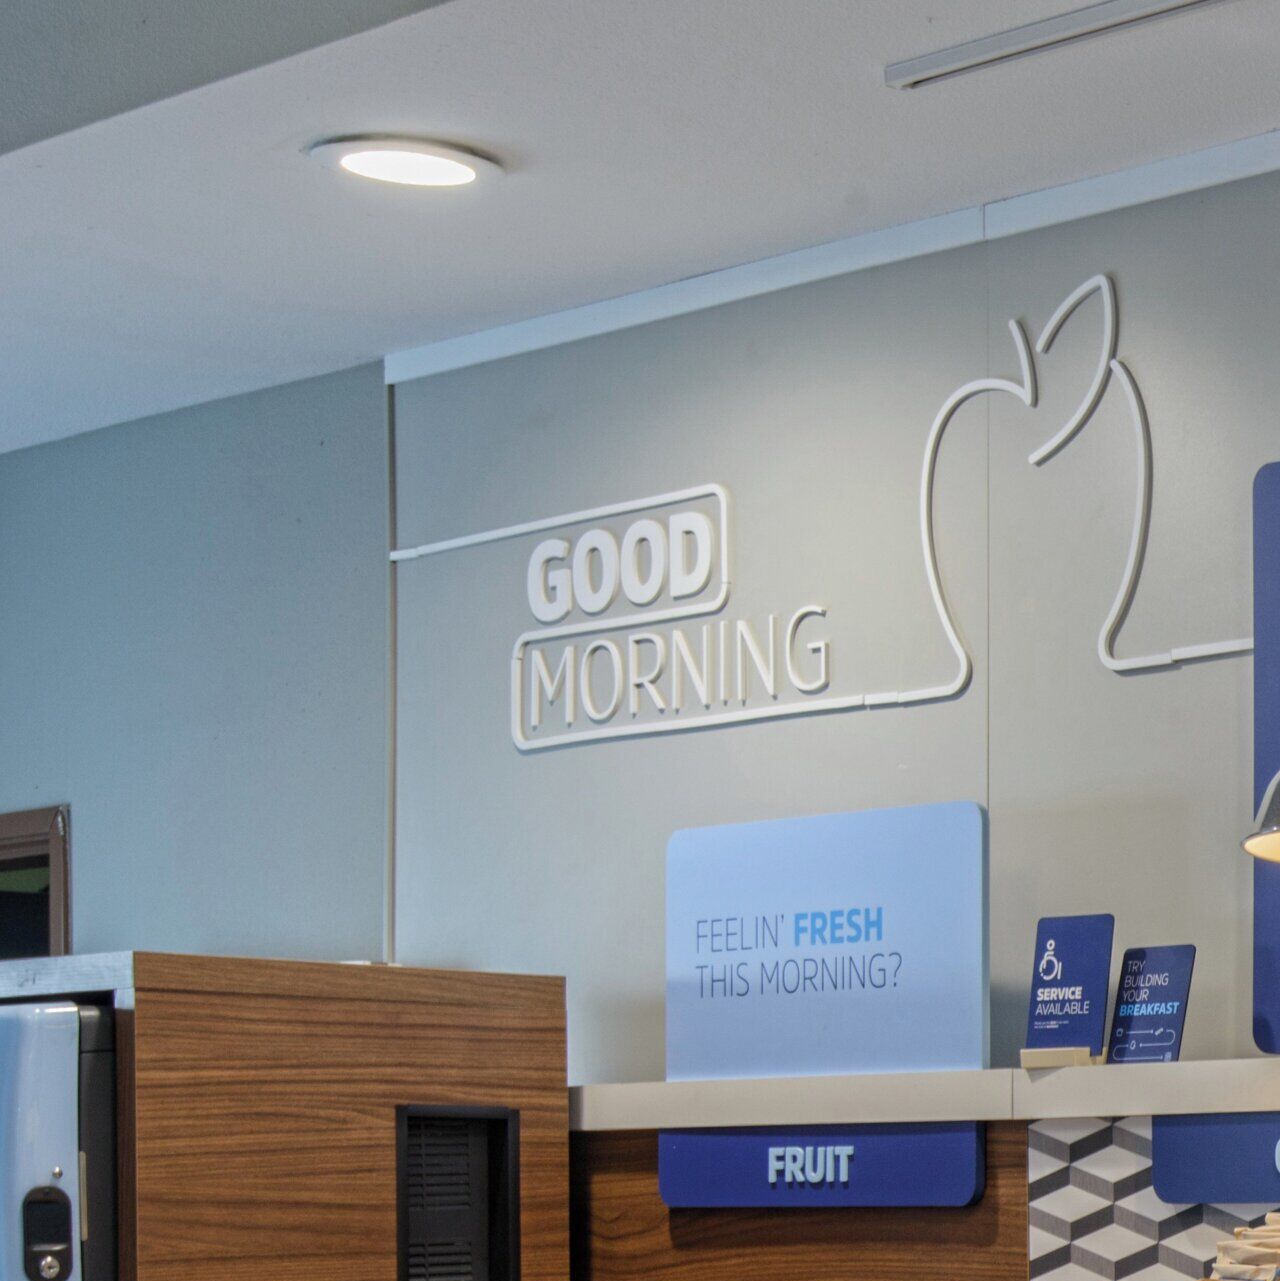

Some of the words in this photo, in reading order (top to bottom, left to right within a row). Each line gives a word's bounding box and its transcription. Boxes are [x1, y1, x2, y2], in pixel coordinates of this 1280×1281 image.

[526, 510, 712, 623] GOOD
[530, 605, 830, 729] MORNING
[695, 914, 785, 954] FEELIN'
[793, 906, 884, 948] FRESH
[1127, 960, 1146, 973] TRY
[695, 961, 750, 999] THIS
[759, 952, 903, 995] MORNING?
[1124, 972, 1169, 988] BUILDING
[1036, 986, 1083, 1001] SERVICE
[1122, 989, 1150, 1002] YOUR
[1034, 1001, 1090, 1016] AVAILABLE
[1119, 1002, 1180, 1017] BREAKFAST
[767, 1145, 855, 1184] FRUIT
